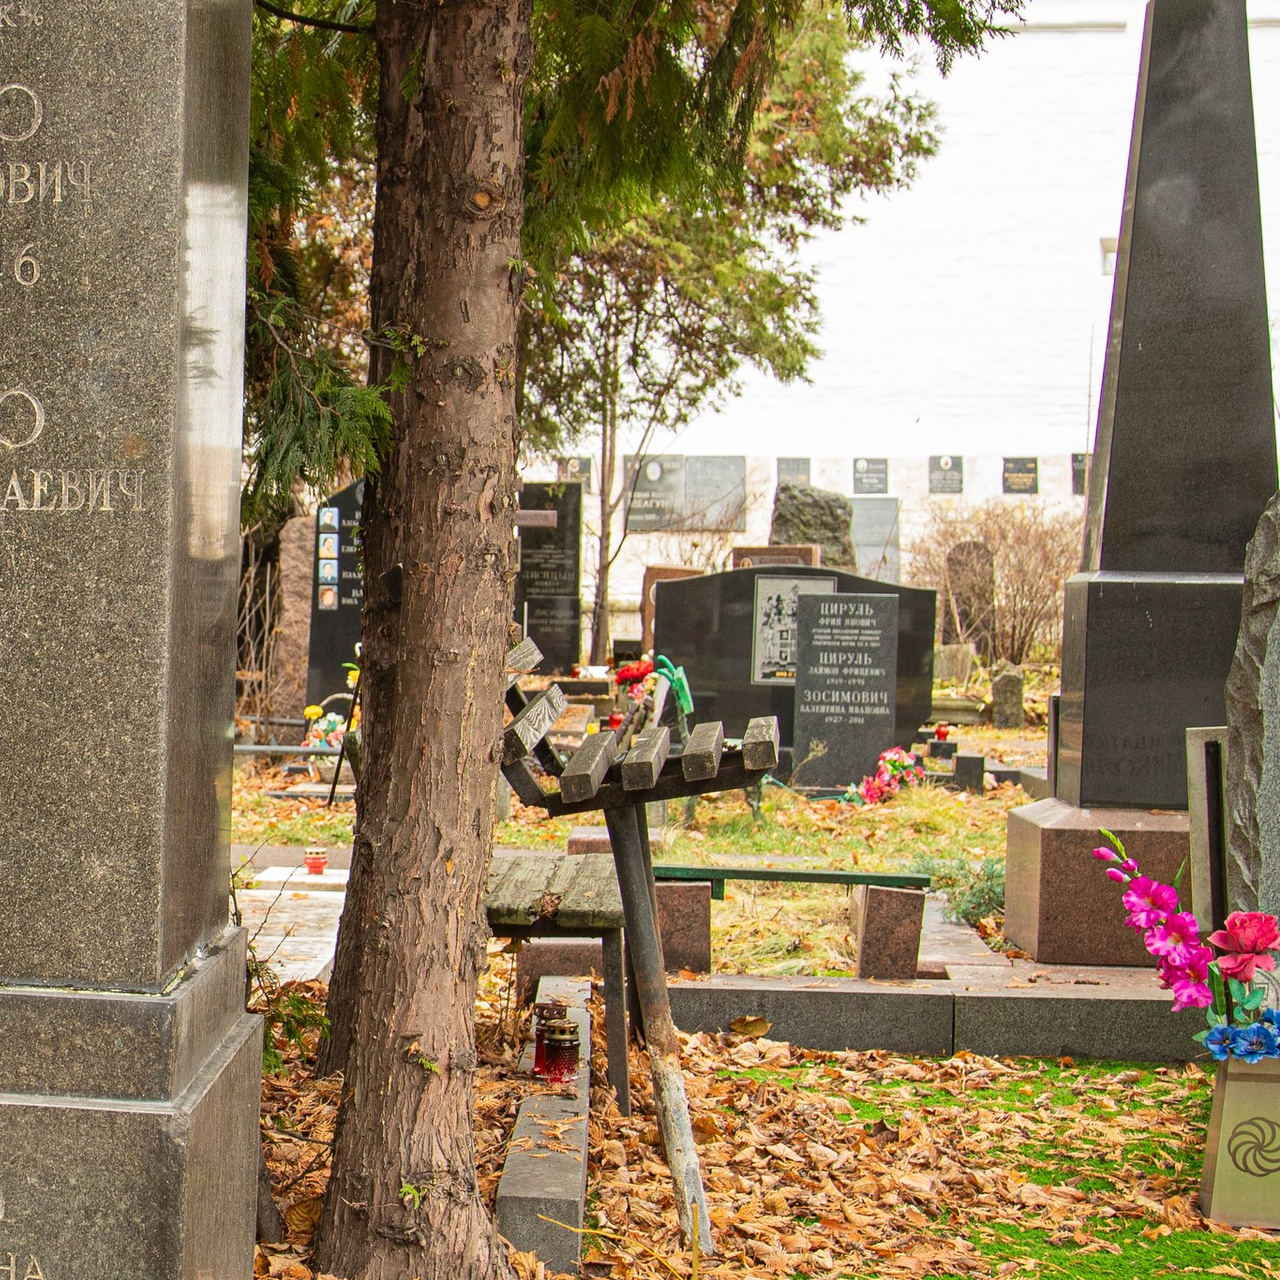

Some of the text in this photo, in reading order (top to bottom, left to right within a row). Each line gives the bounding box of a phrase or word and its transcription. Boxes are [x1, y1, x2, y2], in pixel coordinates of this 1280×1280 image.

[820, 602, 874, 615] ЦИРУЛЬ
[819, 651, 873, 664] ЦИРУЛЬ
[803, 689, 889, 704] ЗОСИМОВИЧ
[800, 704, 890, 715] ВАЛЕНТИНА ИВАНОВНА
